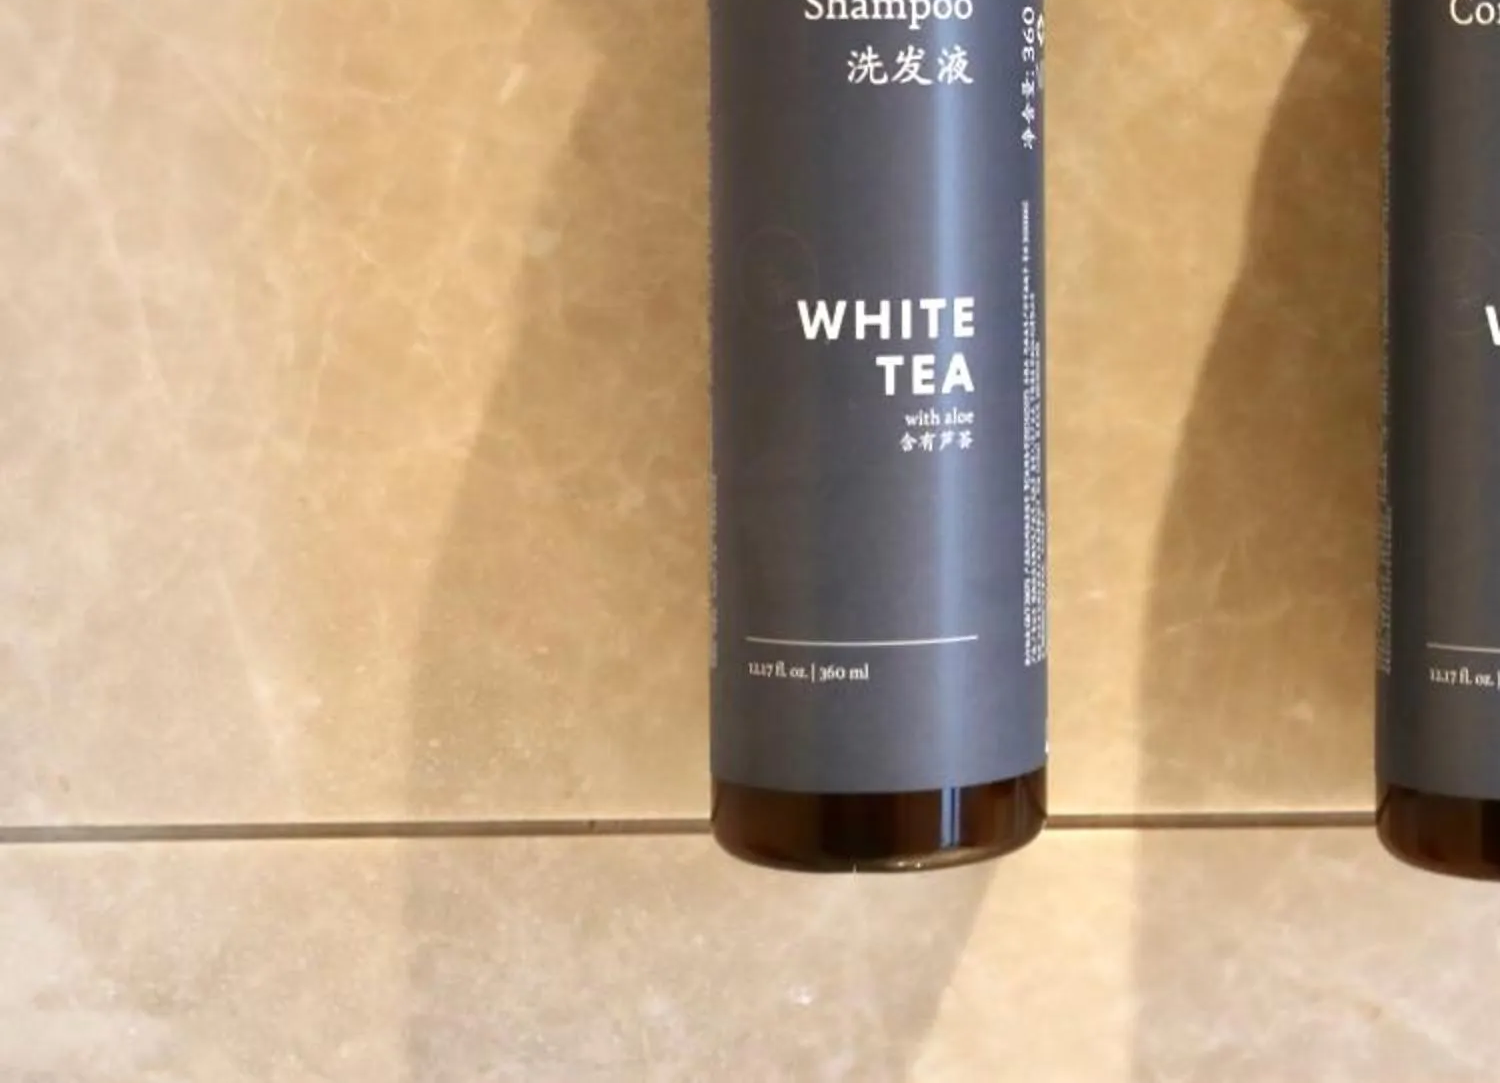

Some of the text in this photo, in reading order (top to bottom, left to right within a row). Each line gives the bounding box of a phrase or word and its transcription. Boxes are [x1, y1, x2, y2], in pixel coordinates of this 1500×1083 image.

[1020, 6, 1036, 63] 360
[846, 44, 974, 85] 洗发液
[797, 297, 976, 341] WHITE
[875, 352, 975, 397] TEA
[904, 407, 941, 427] with
[818, 663, 847, 683] 360
[849, 661, 869, 681] ml
